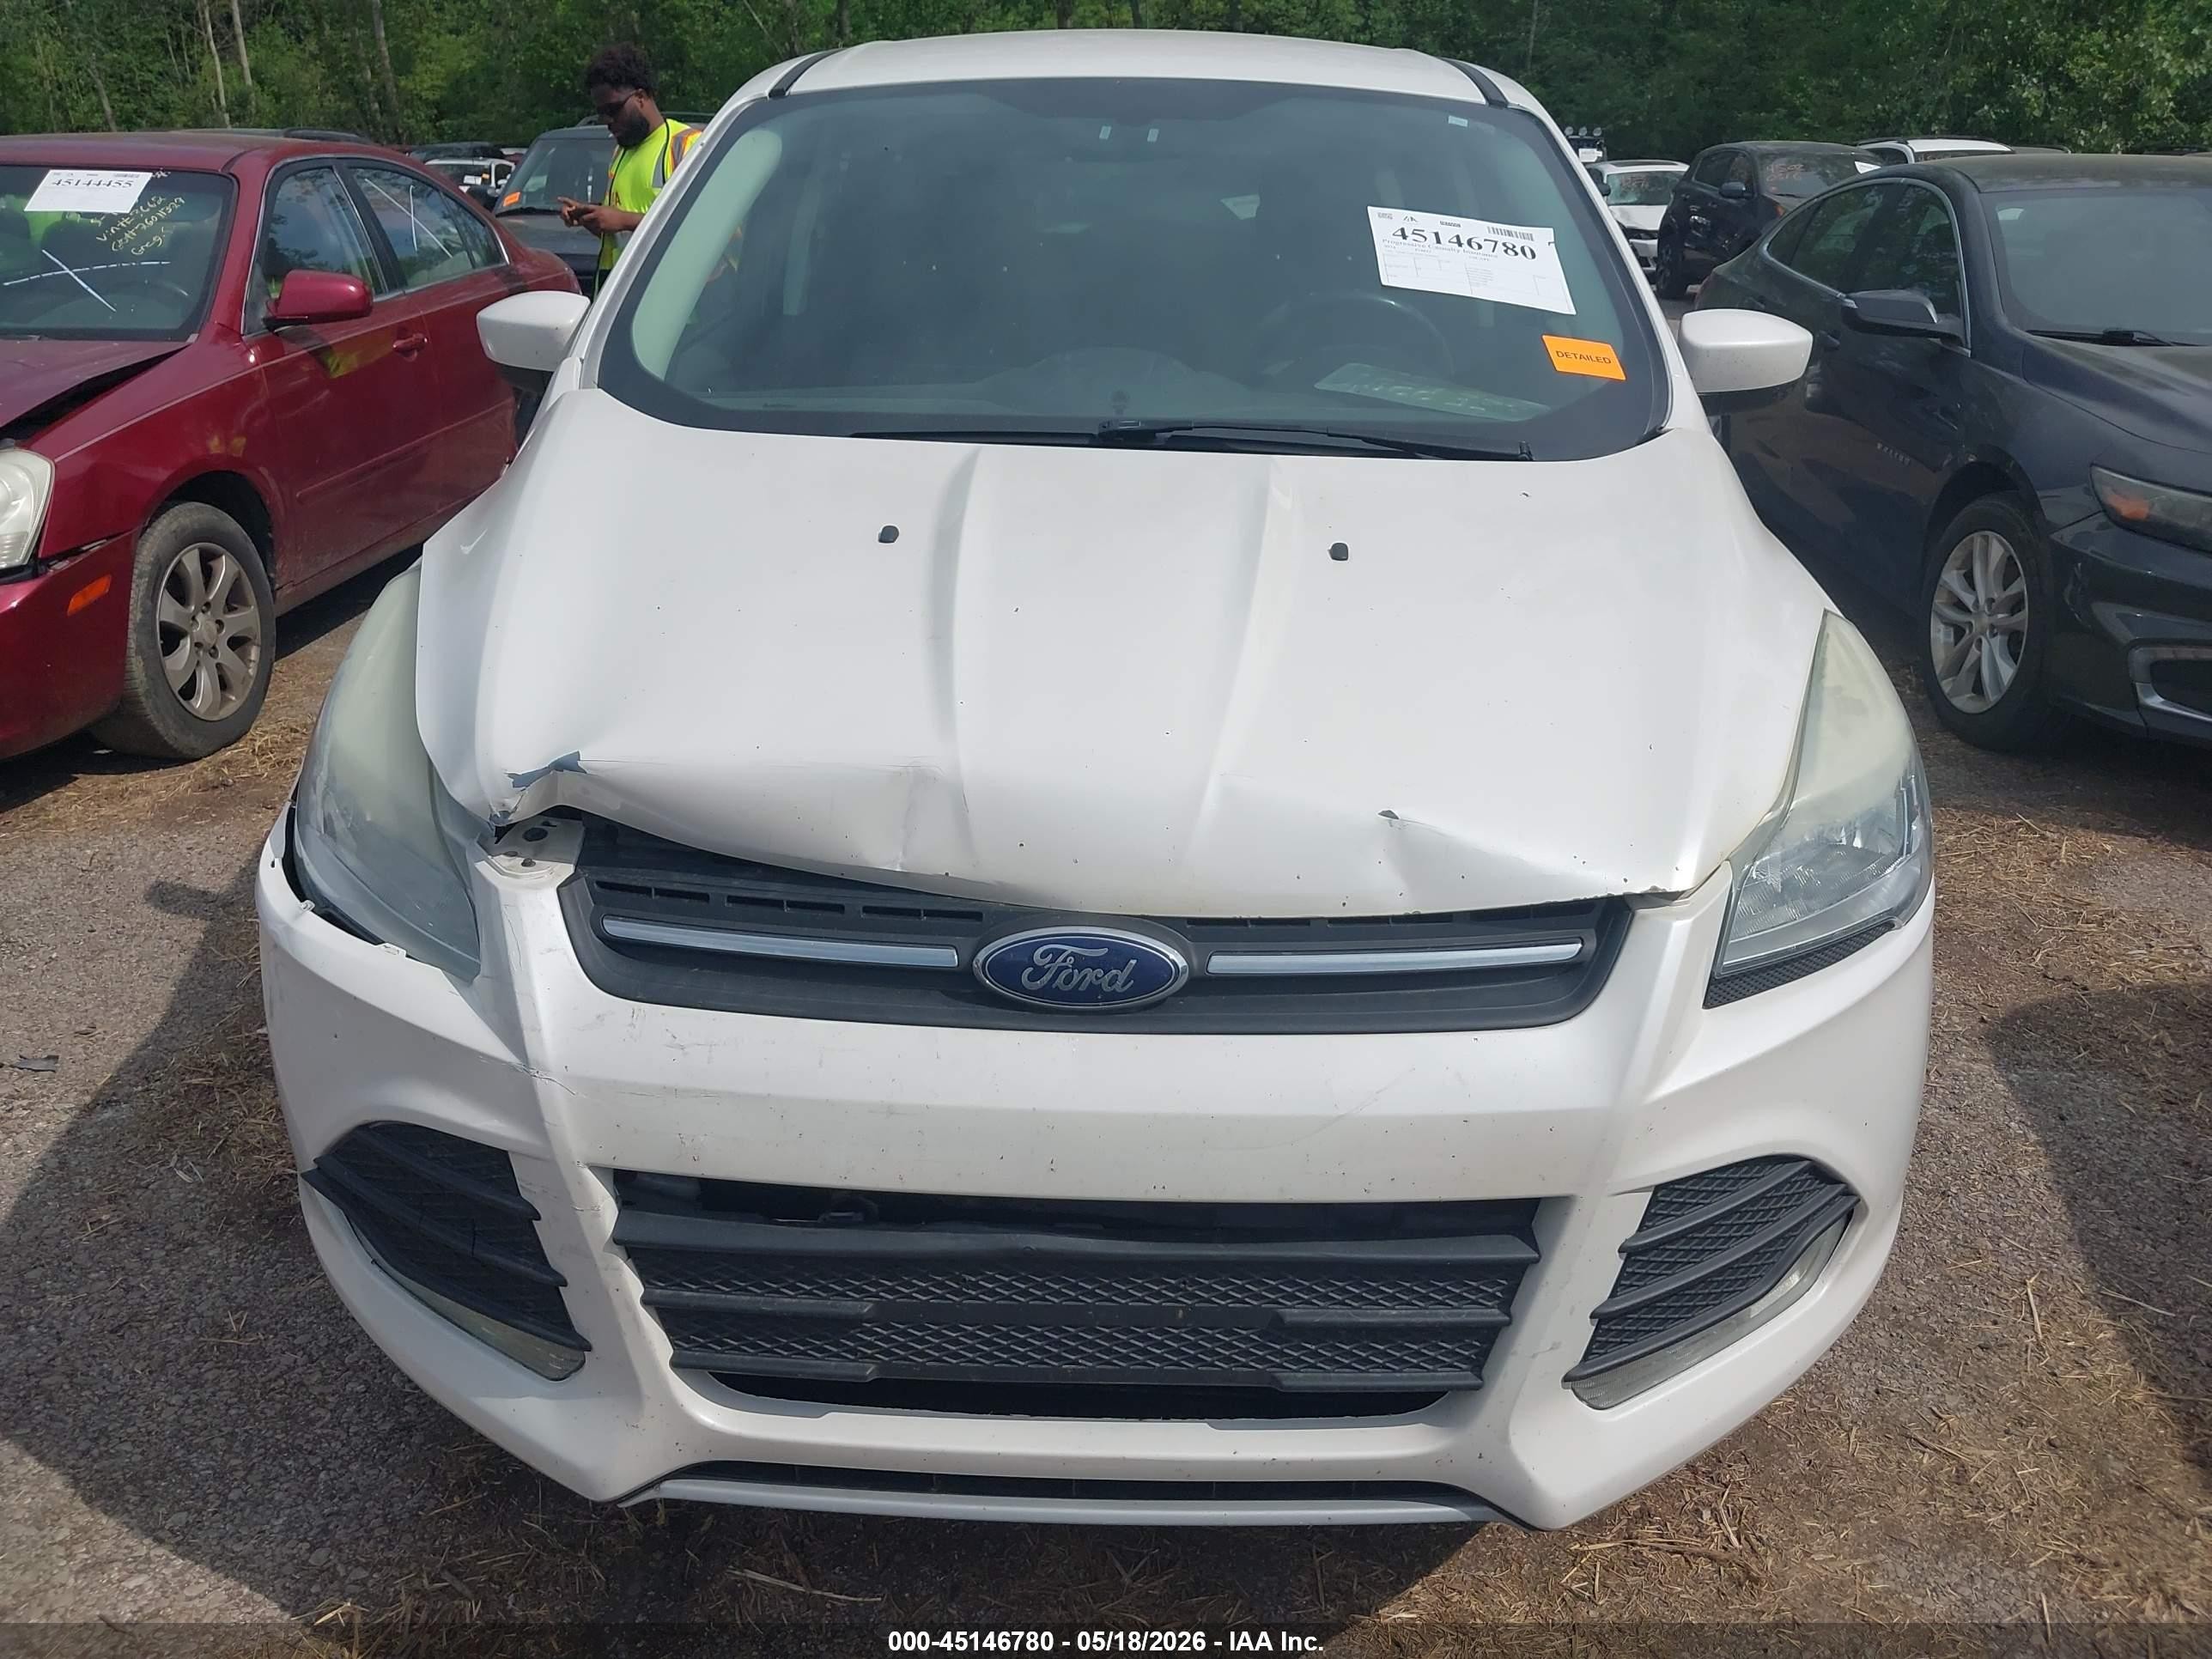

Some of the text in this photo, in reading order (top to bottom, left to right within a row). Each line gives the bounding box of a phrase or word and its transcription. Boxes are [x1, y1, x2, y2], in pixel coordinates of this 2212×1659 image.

[52, 179, 134, 188] 45144455
[1382, 238, 1426, 248] Progressive
[1392, 227, 1536, 260] 45146780
[1556, 350, 1612, 364] DETAILED
[1021, 944, 1139, 992] Ford
